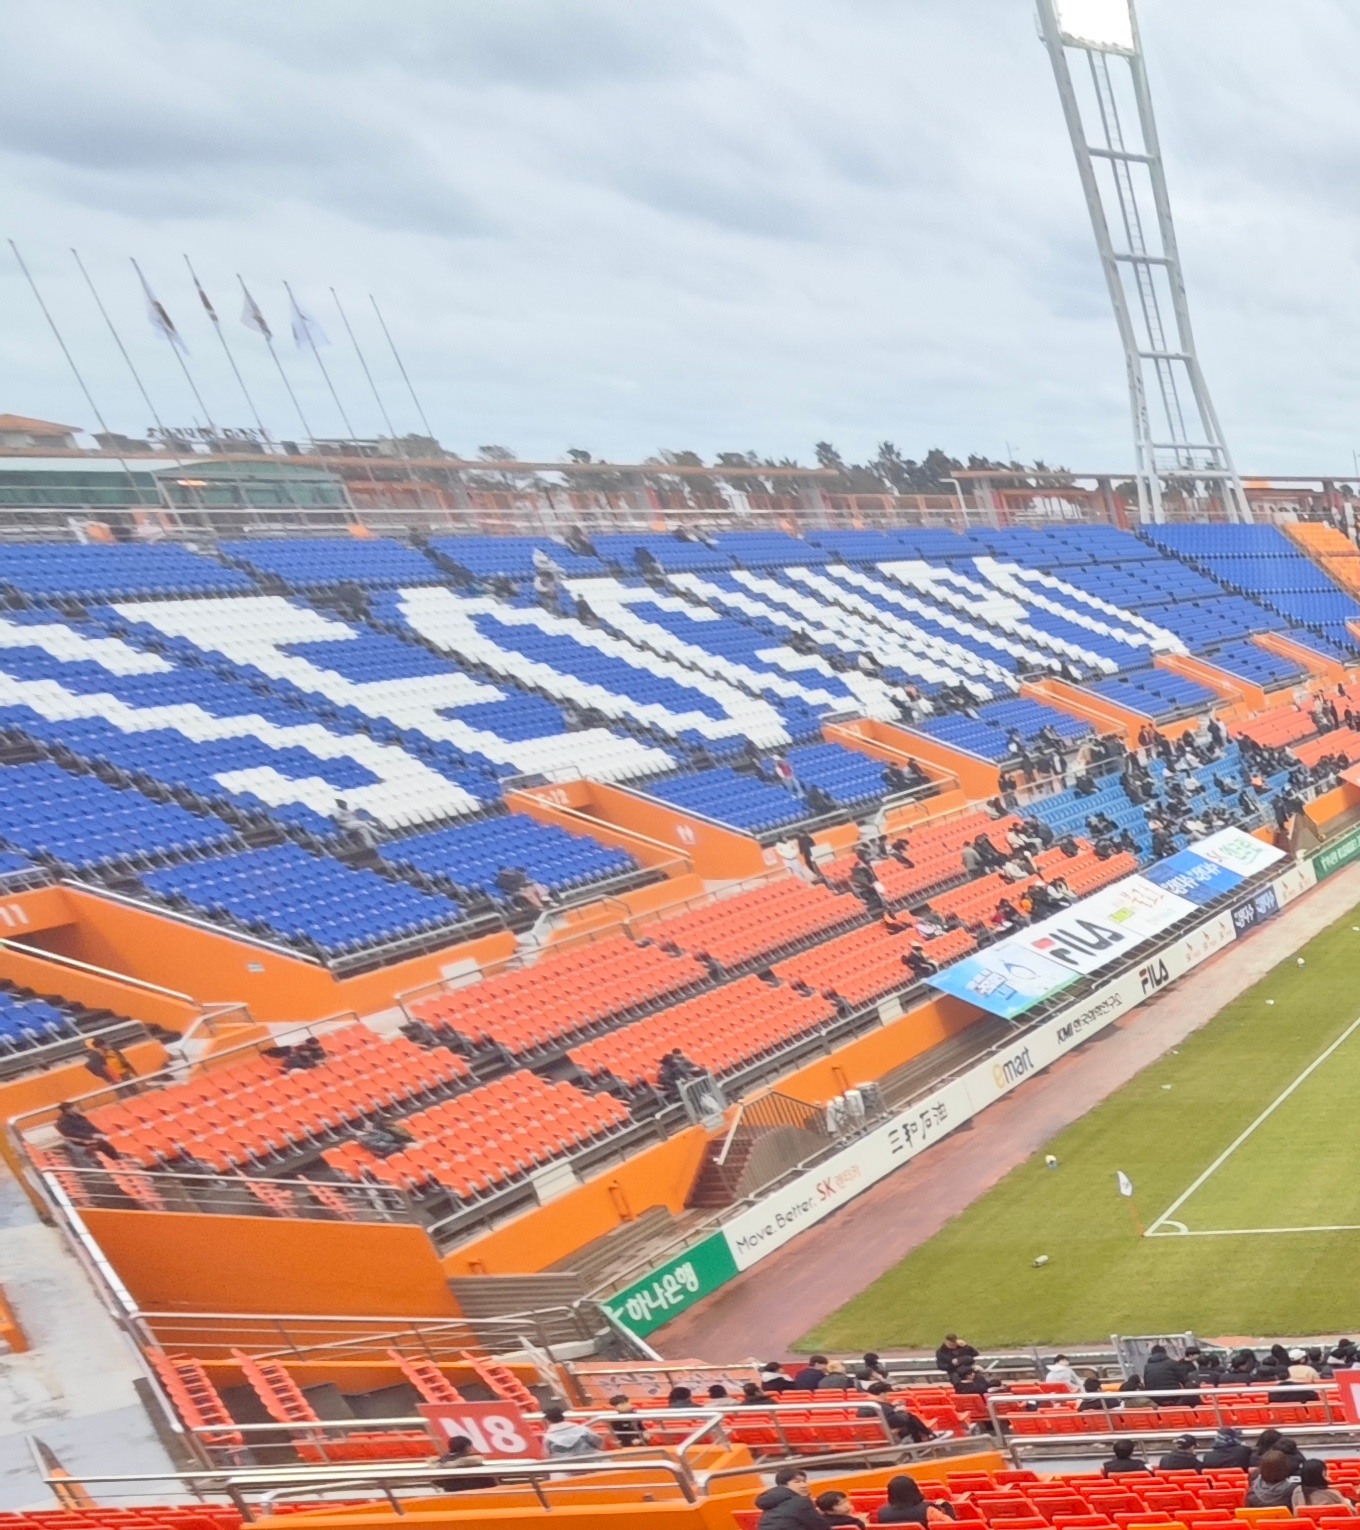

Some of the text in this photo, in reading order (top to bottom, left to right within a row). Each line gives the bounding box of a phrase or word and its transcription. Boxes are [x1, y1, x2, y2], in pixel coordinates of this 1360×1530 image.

[1031, 919, 1126, 966] FILA
[1139, 958, 1170, 995] FILA
[1056, 1023, 1074, 1046] KMI
[993, 1045, 1035, 1089] emart
[734, 1223, 776, 1255] Move.
[775, 1196, 817, 1230] Better.
[816, 1177, 838, 1198] SK
[625, 1260, 700, 1321] 하나은행
[439, 1412, 528, 1457] N8
